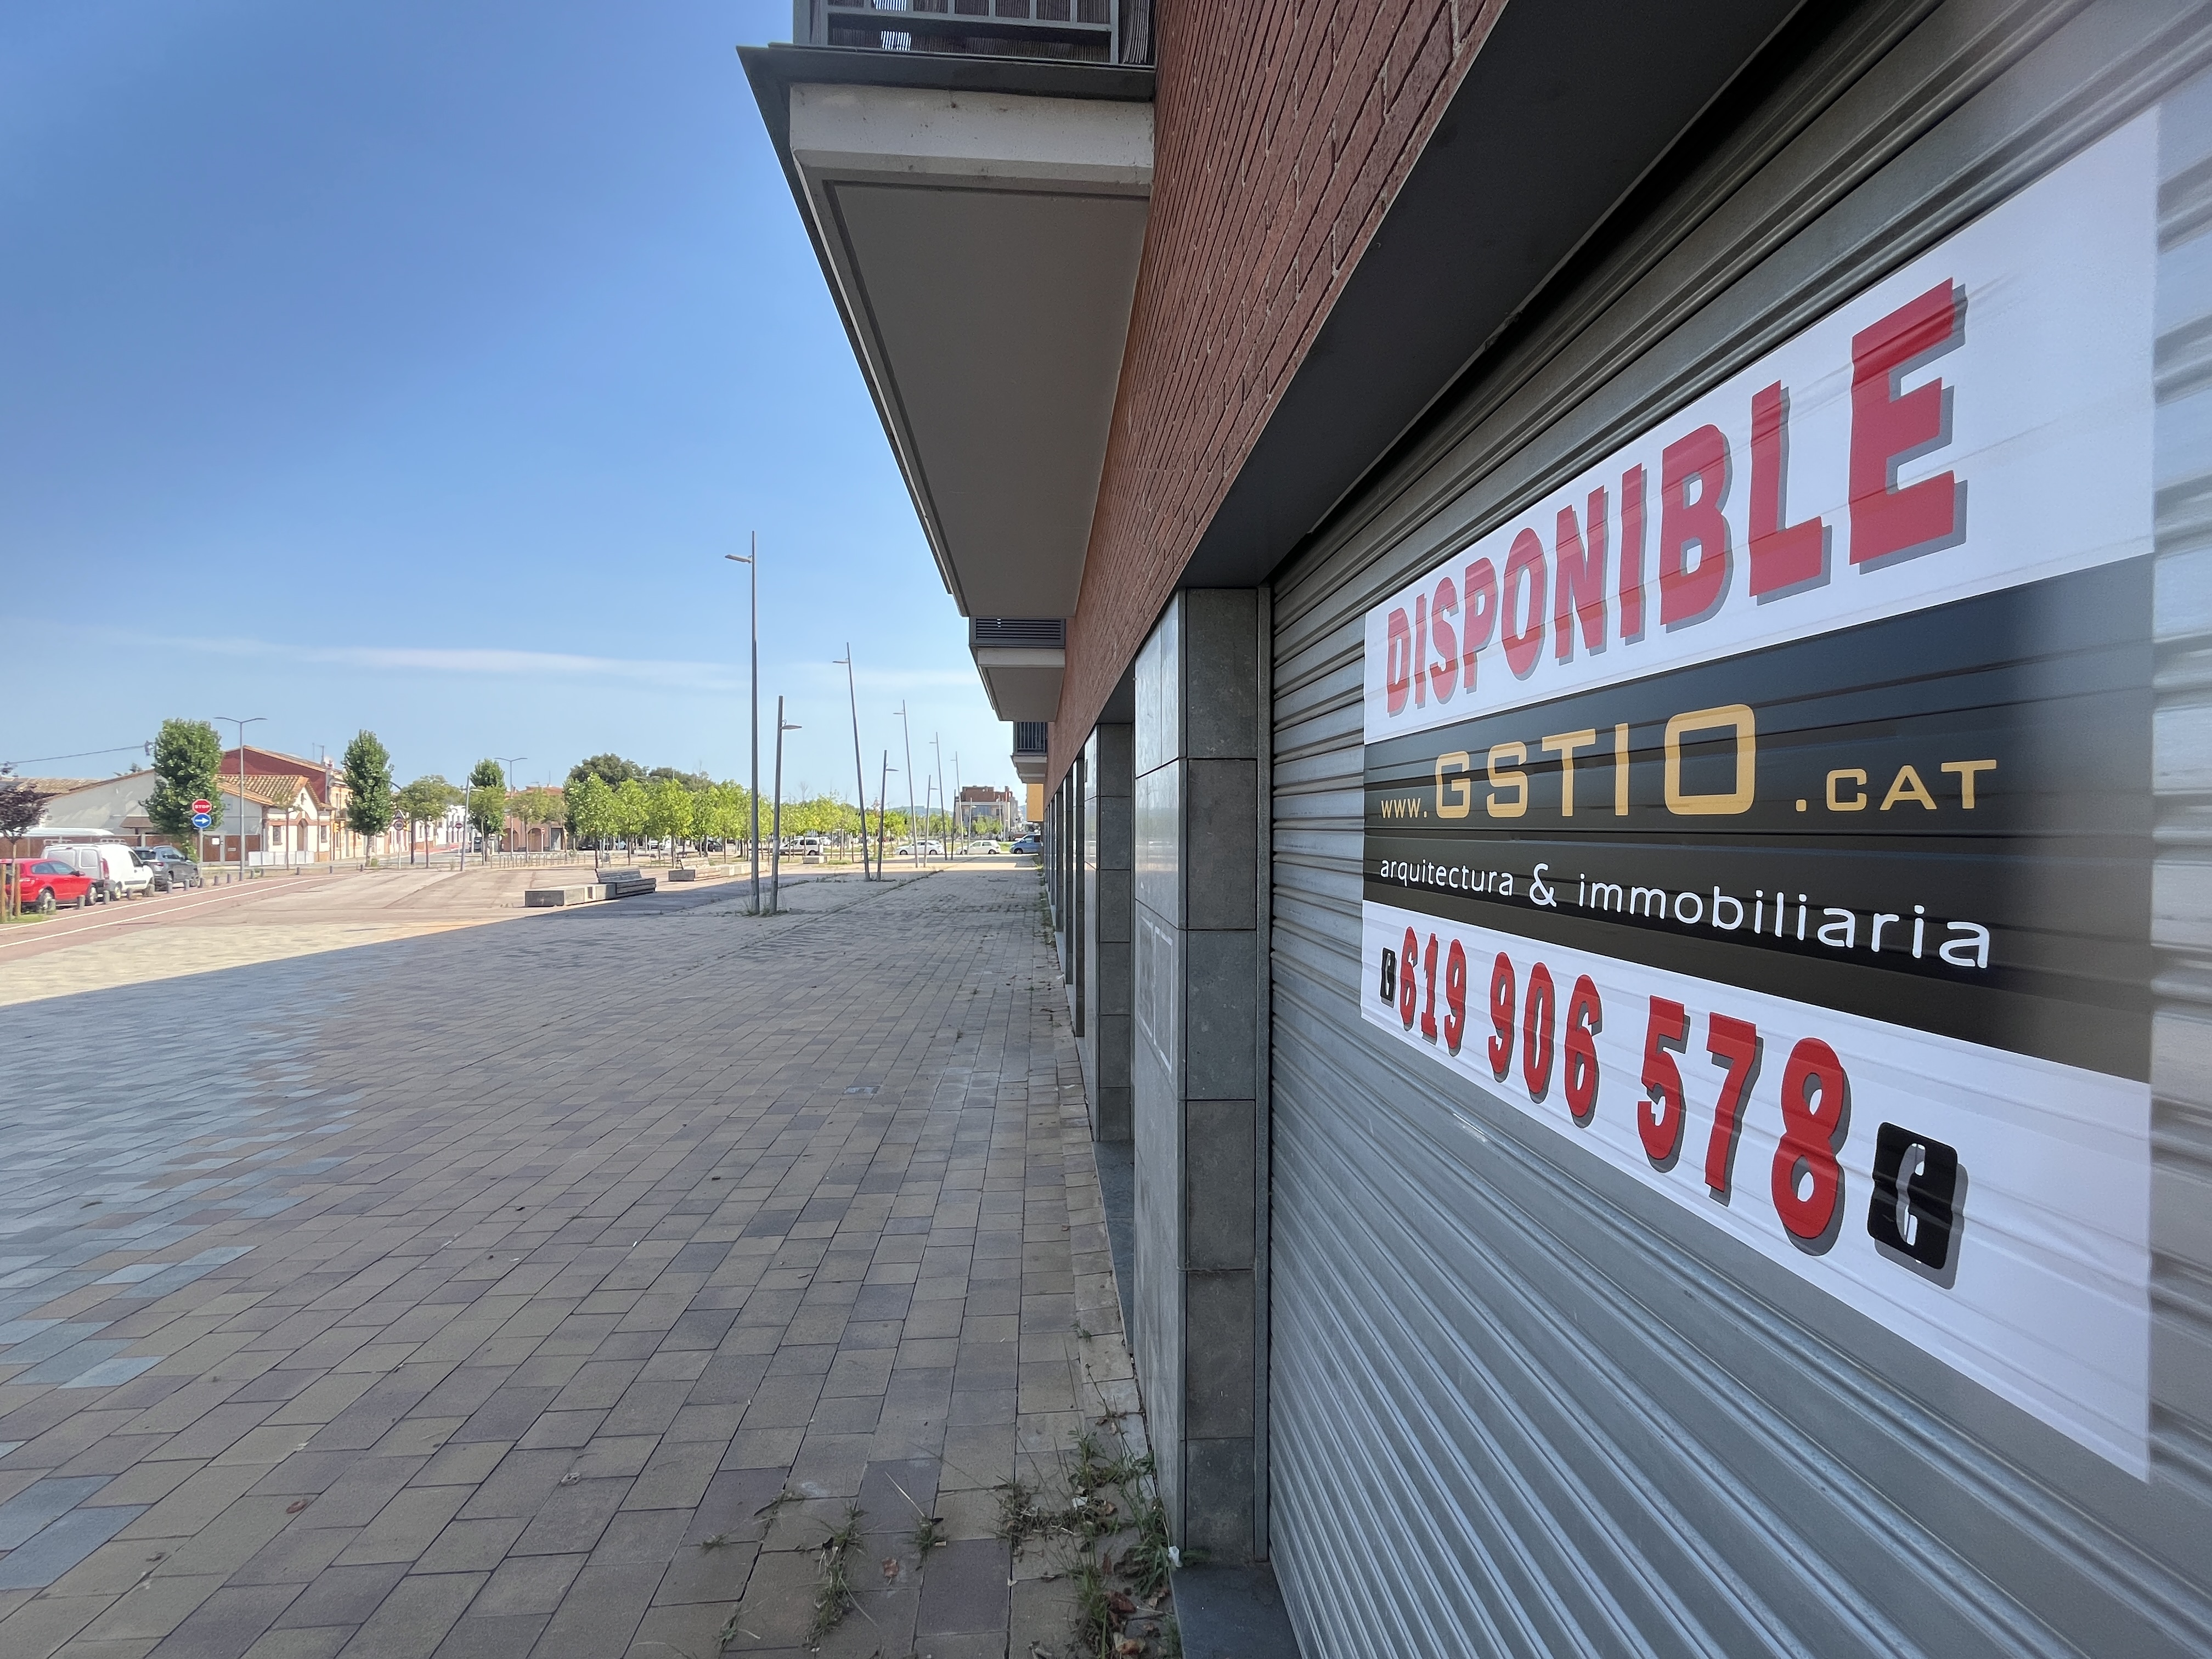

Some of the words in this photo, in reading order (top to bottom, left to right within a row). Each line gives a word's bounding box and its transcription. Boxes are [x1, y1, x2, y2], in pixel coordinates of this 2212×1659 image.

[1387, 278, 1967, 718] DISPONIBLE
[1380, 857, 1514, 896] arquitectura
[1529, 863, 1558, 907] &
[1578, 873, 1990, 969] immobiliaria
[1400, 926, 1467, 1056] 619
[1488, 952, 1601, 1128] 906
[1637, 995, 1852, 1256] 578
